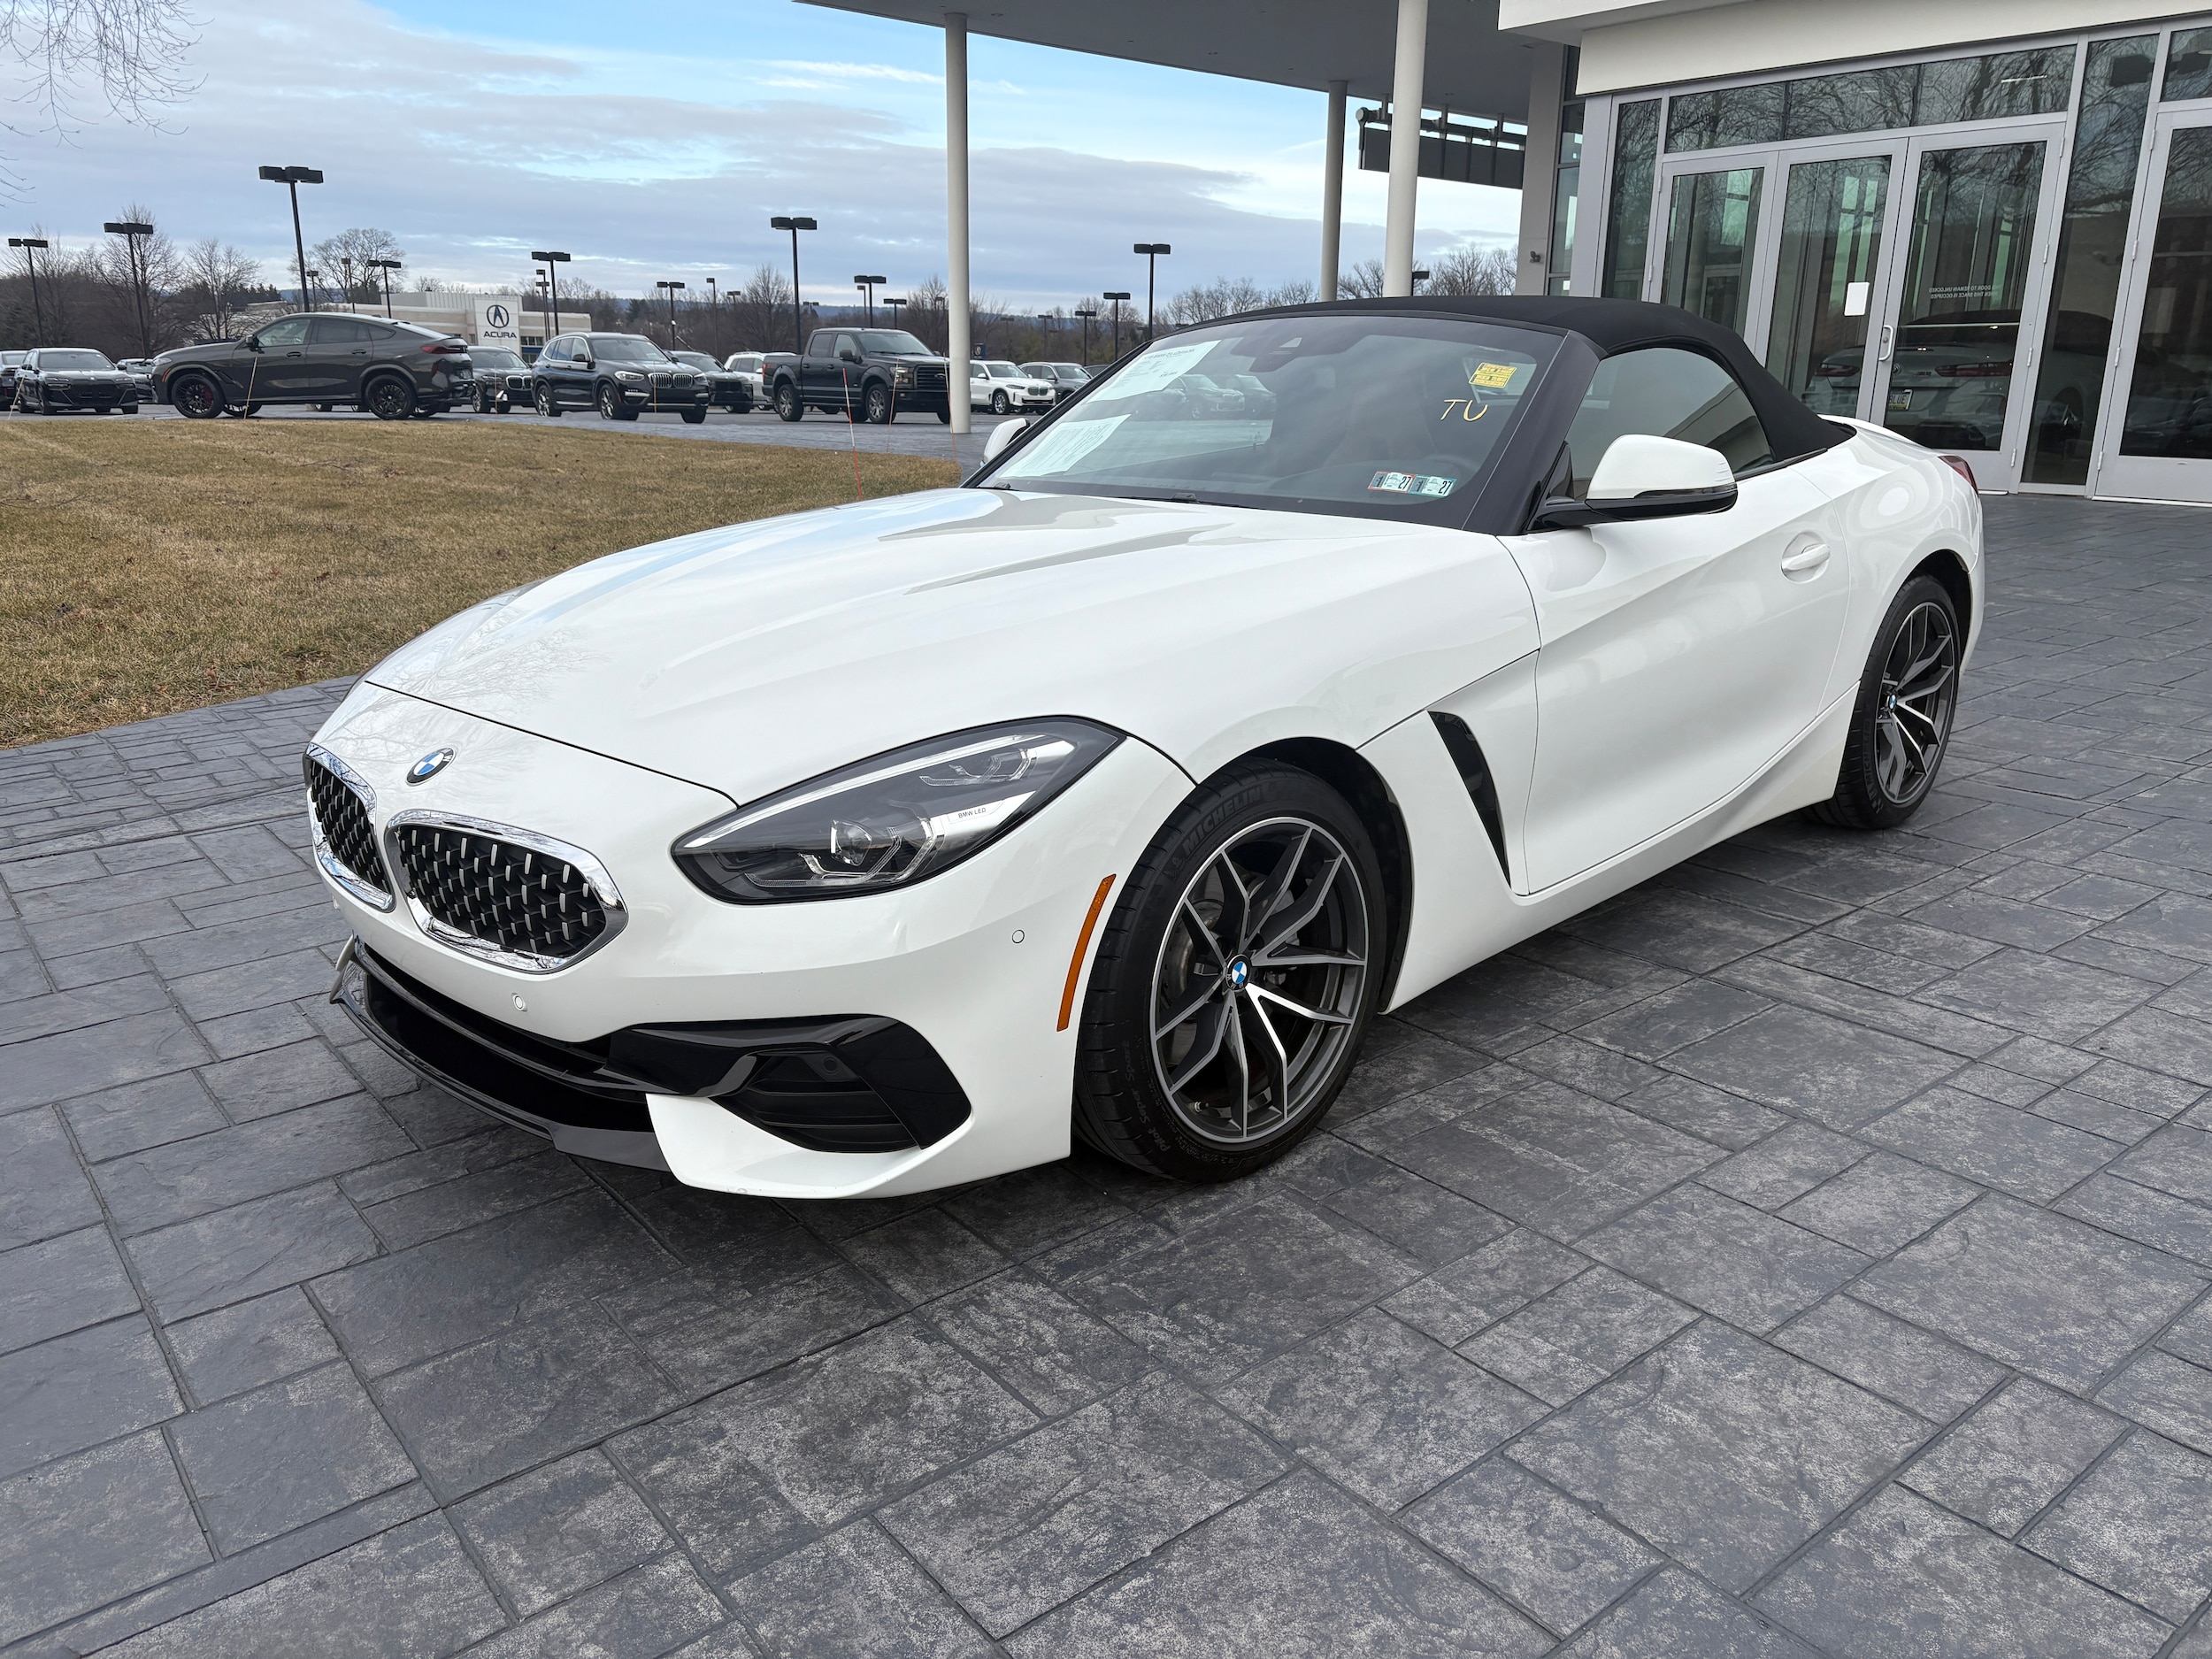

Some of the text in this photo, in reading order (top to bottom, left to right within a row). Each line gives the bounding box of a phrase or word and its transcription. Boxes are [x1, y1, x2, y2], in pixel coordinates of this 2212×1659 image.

[1398, 476, 1411, 490] 27
[1438, 480, 1452, 495] 27
[1180, 785, 1261, 856] MICHELIN
[1122, 1041, 1135, 1082] Sport
[1131, 1088, 1150, 1125] Super
[1148, 1126, 1171, 1152] Pilot
